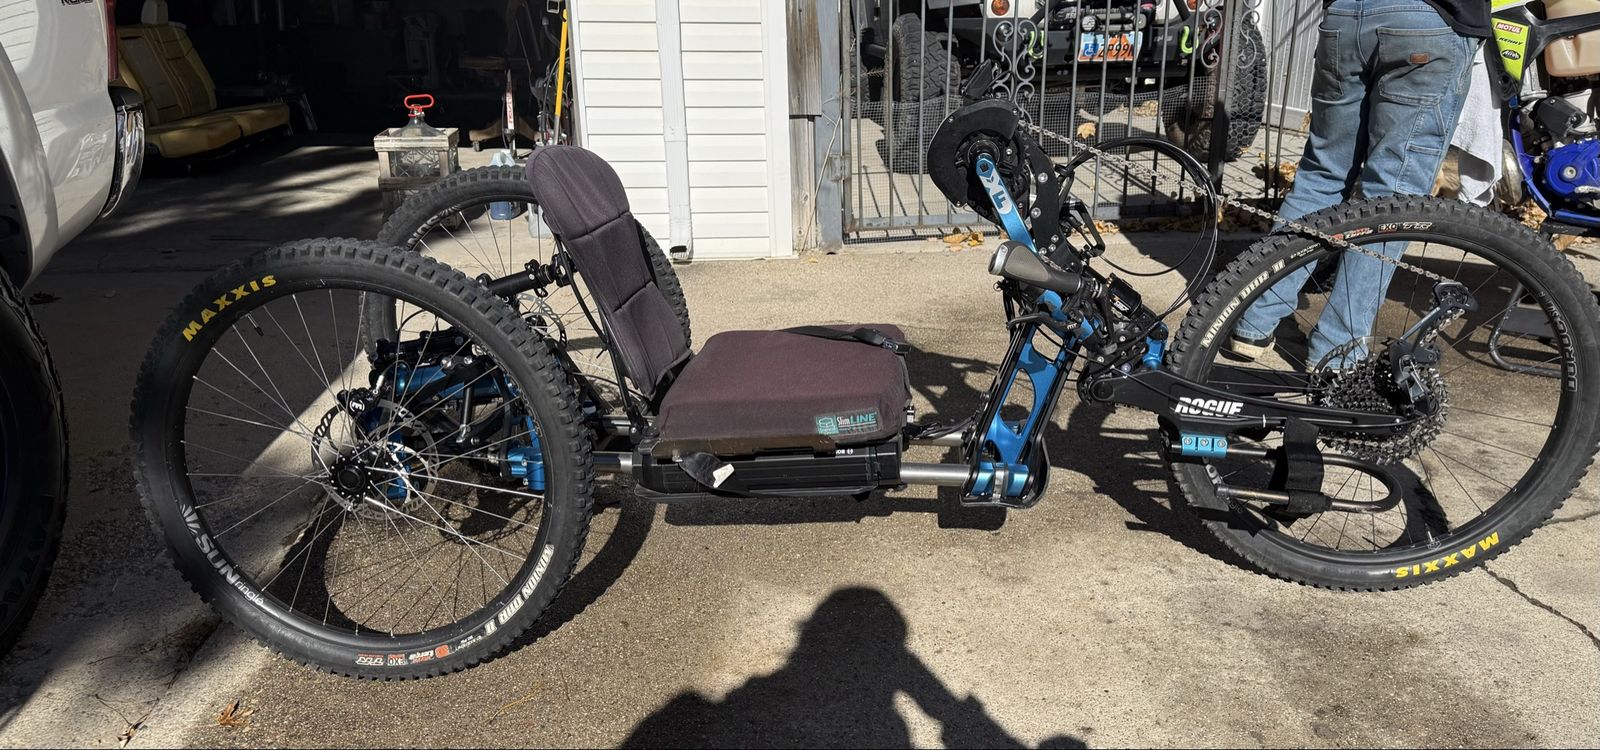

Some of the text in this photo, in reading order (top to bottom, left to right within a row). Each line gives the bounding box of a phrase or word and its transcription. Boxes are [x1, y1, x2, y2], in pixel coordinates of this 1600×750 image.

[1496, 23, 1521, 33] MOTUL
[182, 275, 276, 342] MAXXIS
[1200, 297, 1241, 348] MINION
[1175, 397, 1244, 418] ROGUE
[195, 533, 240, 585] SUN
[1395, 531, 1499, 578] MAXXIS
